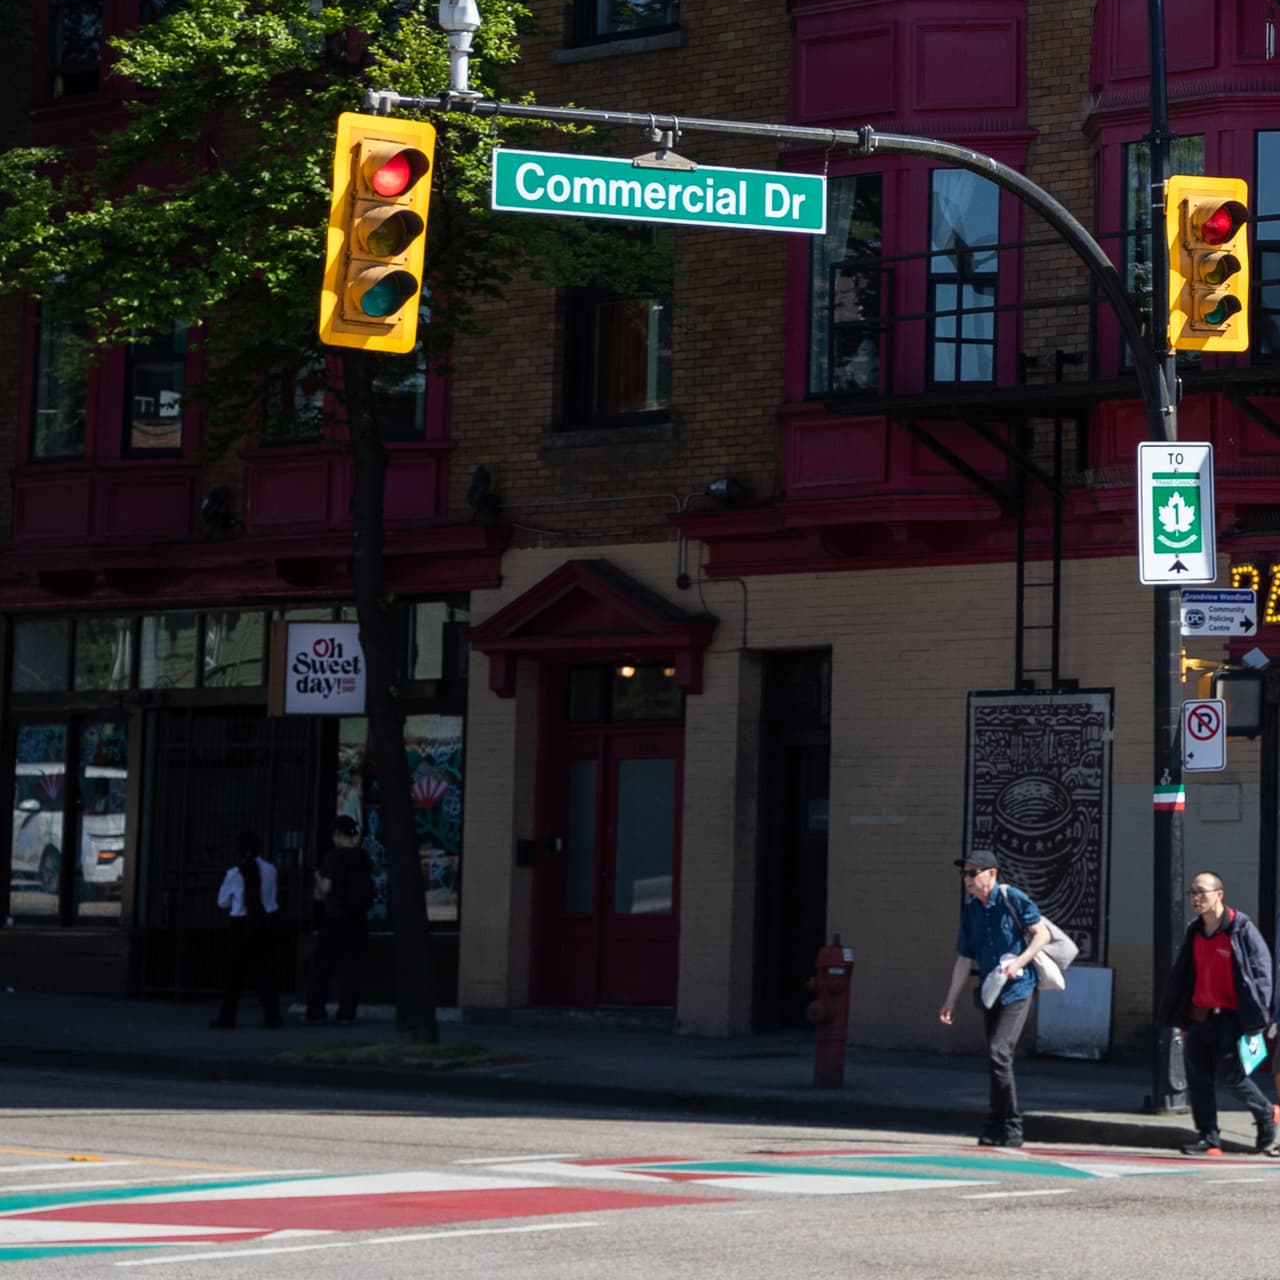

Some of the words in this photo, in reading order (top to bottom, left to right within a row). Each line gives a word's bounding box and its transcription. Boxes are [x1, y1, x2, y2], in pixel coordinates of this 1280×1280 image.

[515, 162, 746, 216] Commercial
[764, 183, 806, 220] Dr
[1167, 452, 1185, 465] TO
[1172, 502, 1180, 526] 1
[312, 637, 344, 658] Oh
[291, 651, 363, 675] Sweet
